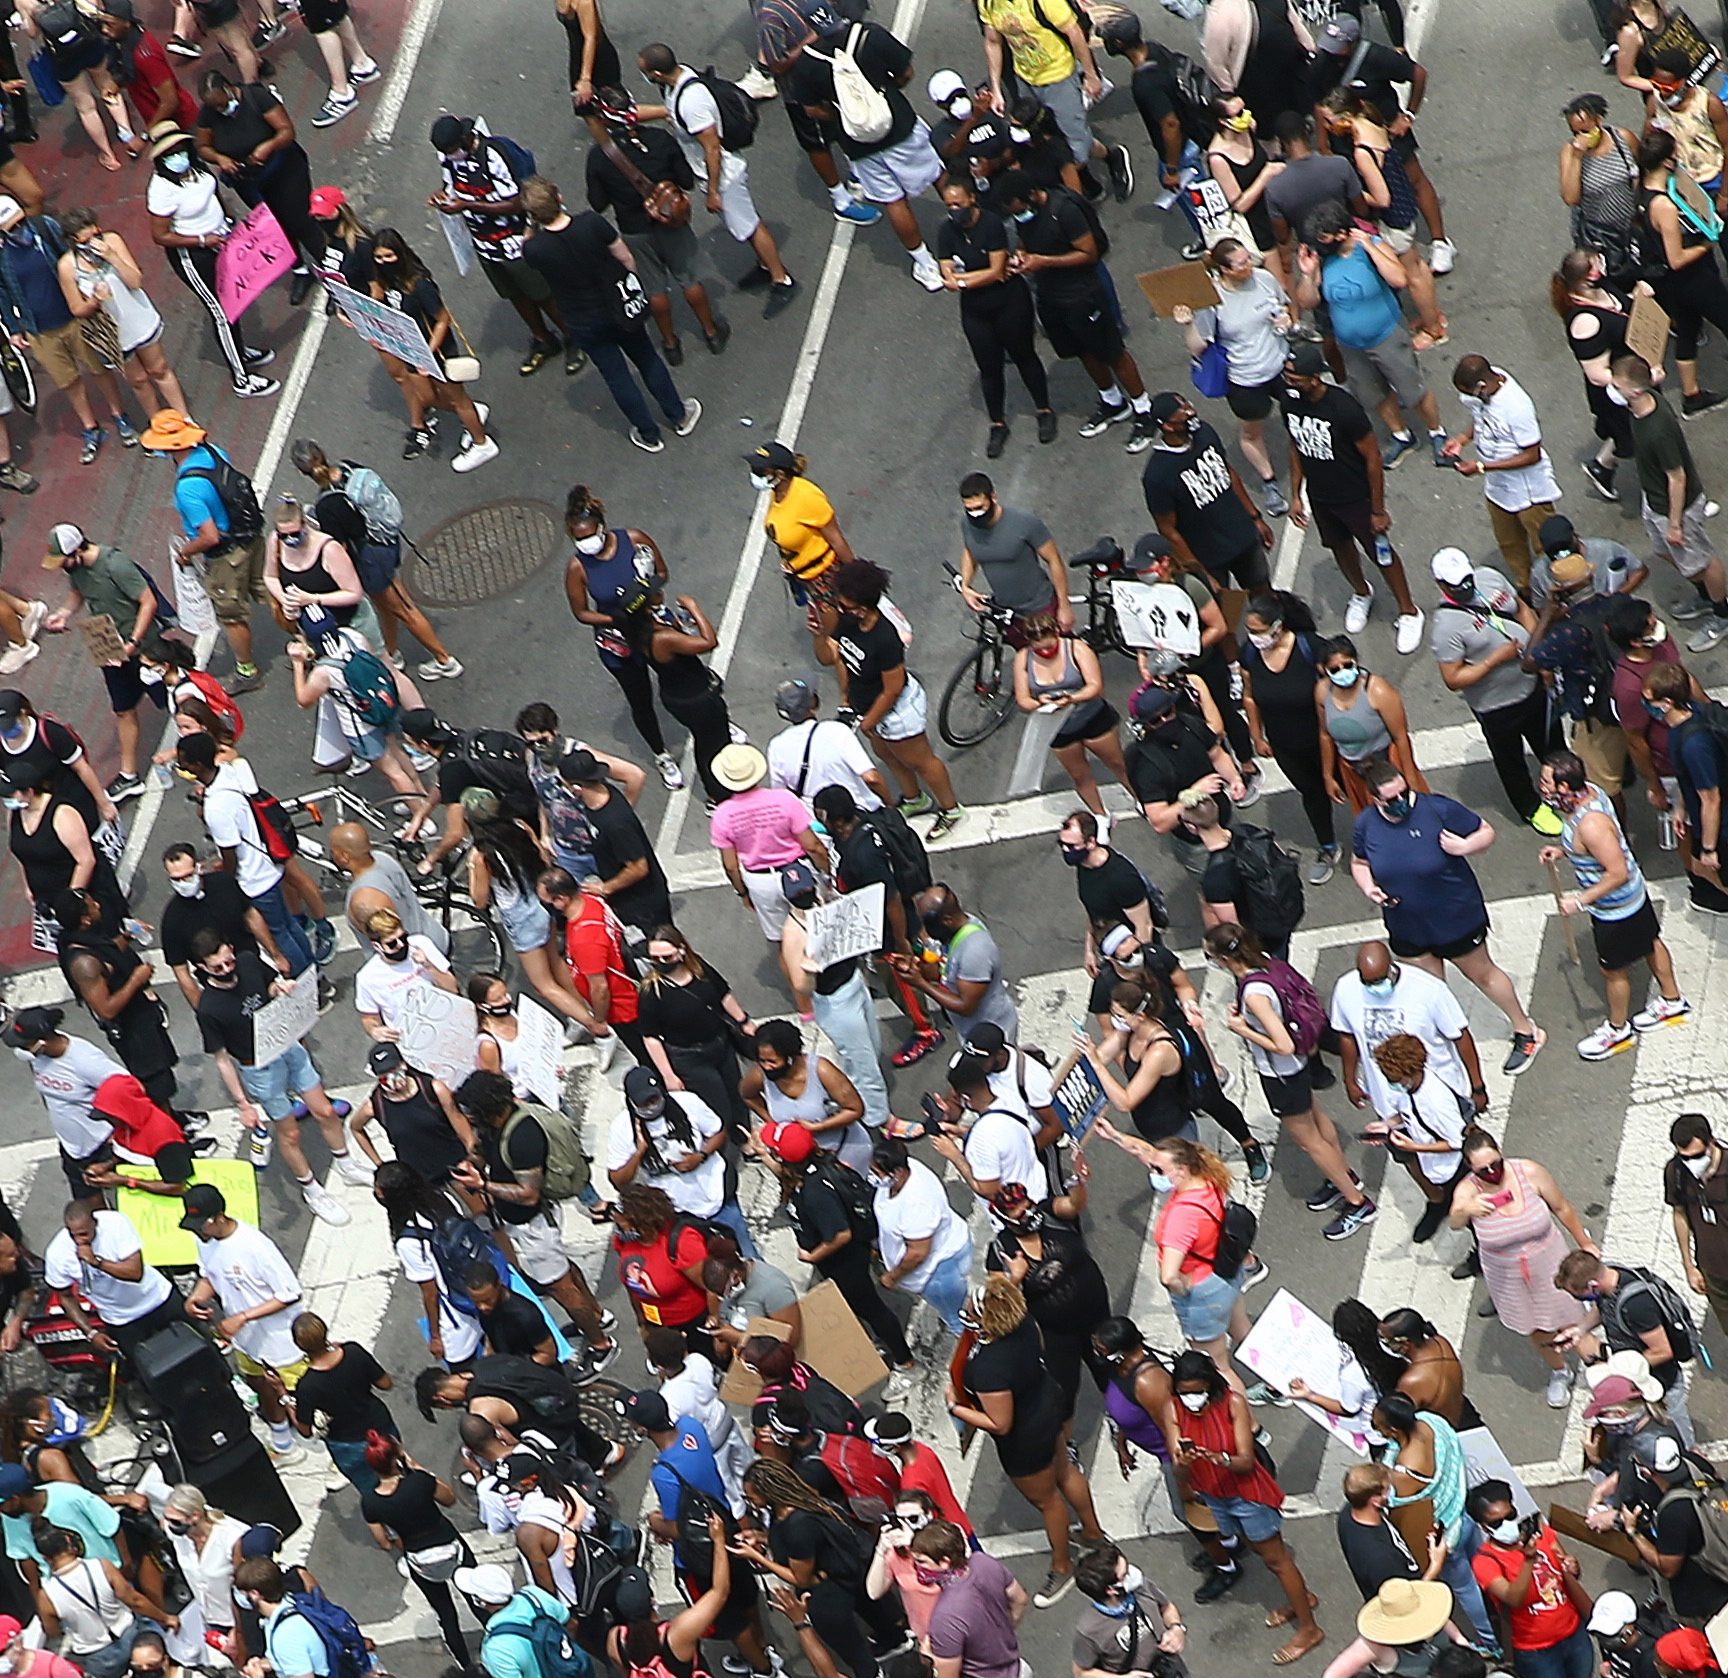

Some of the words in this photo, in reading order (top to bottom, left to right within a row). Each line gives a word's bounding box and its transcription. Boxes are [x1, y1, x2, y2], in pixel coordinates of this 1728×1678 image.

[234, 232, 266, 263] OUR
[233, 239, 287, 300] NECKS
[1053, 1063, 1088, 1105] BLACK
